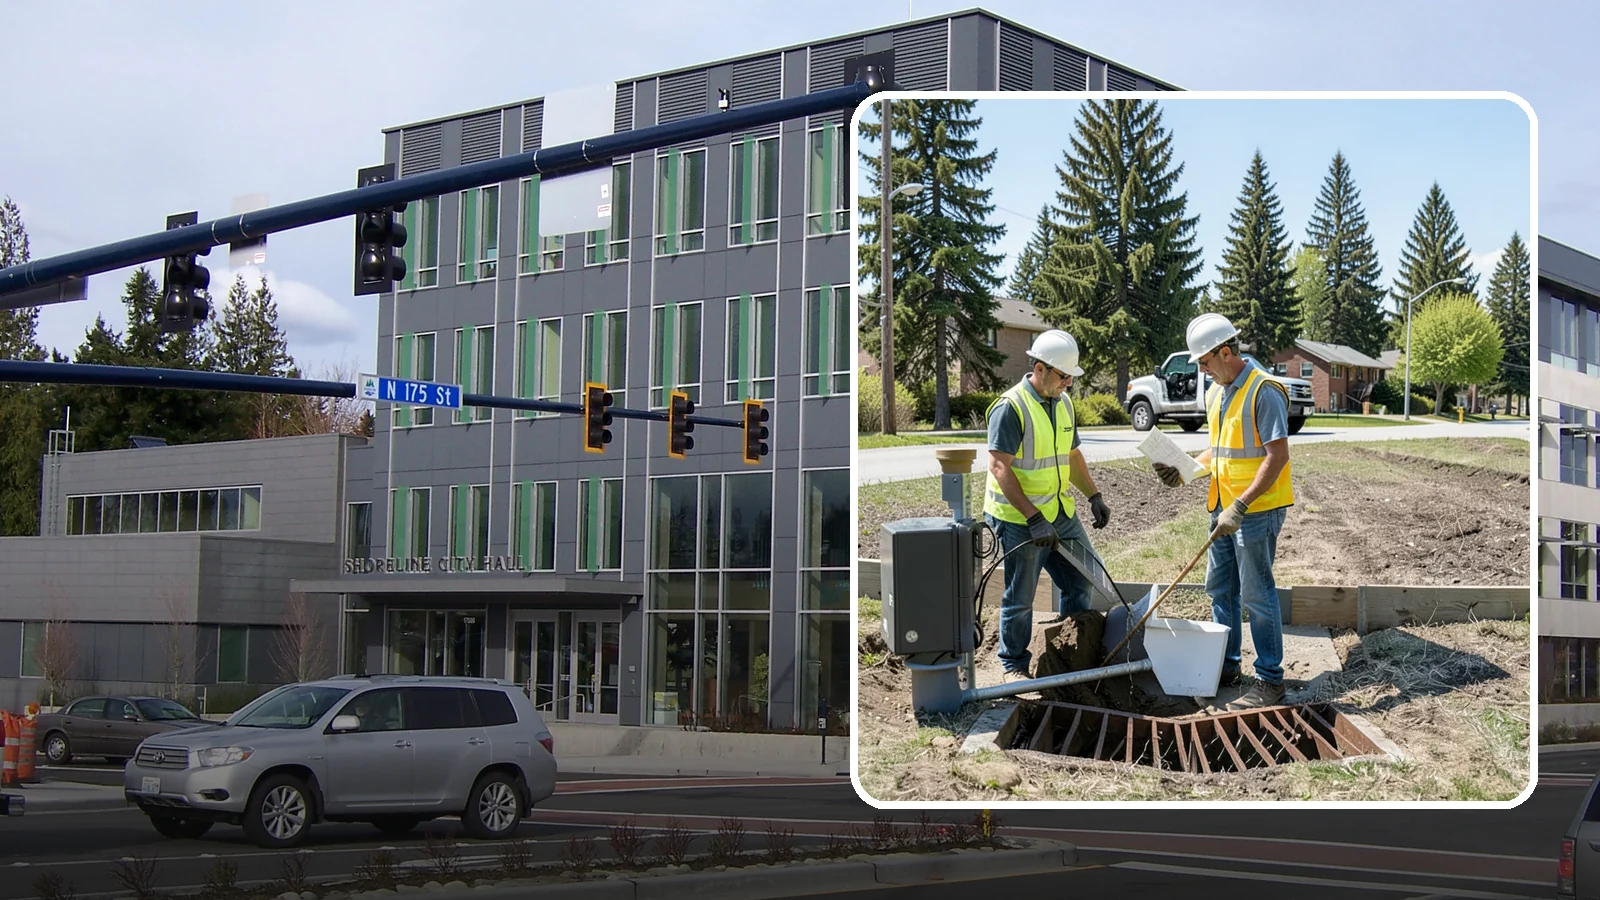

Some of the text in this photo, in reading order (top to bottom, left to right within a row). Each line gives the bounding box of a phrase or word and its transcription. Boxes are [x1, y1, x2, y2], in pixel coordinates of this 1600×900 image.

[387, 380, 451, 406] N 175 St
[344, 555, 525, 574] SHORELINE CITY HALL
